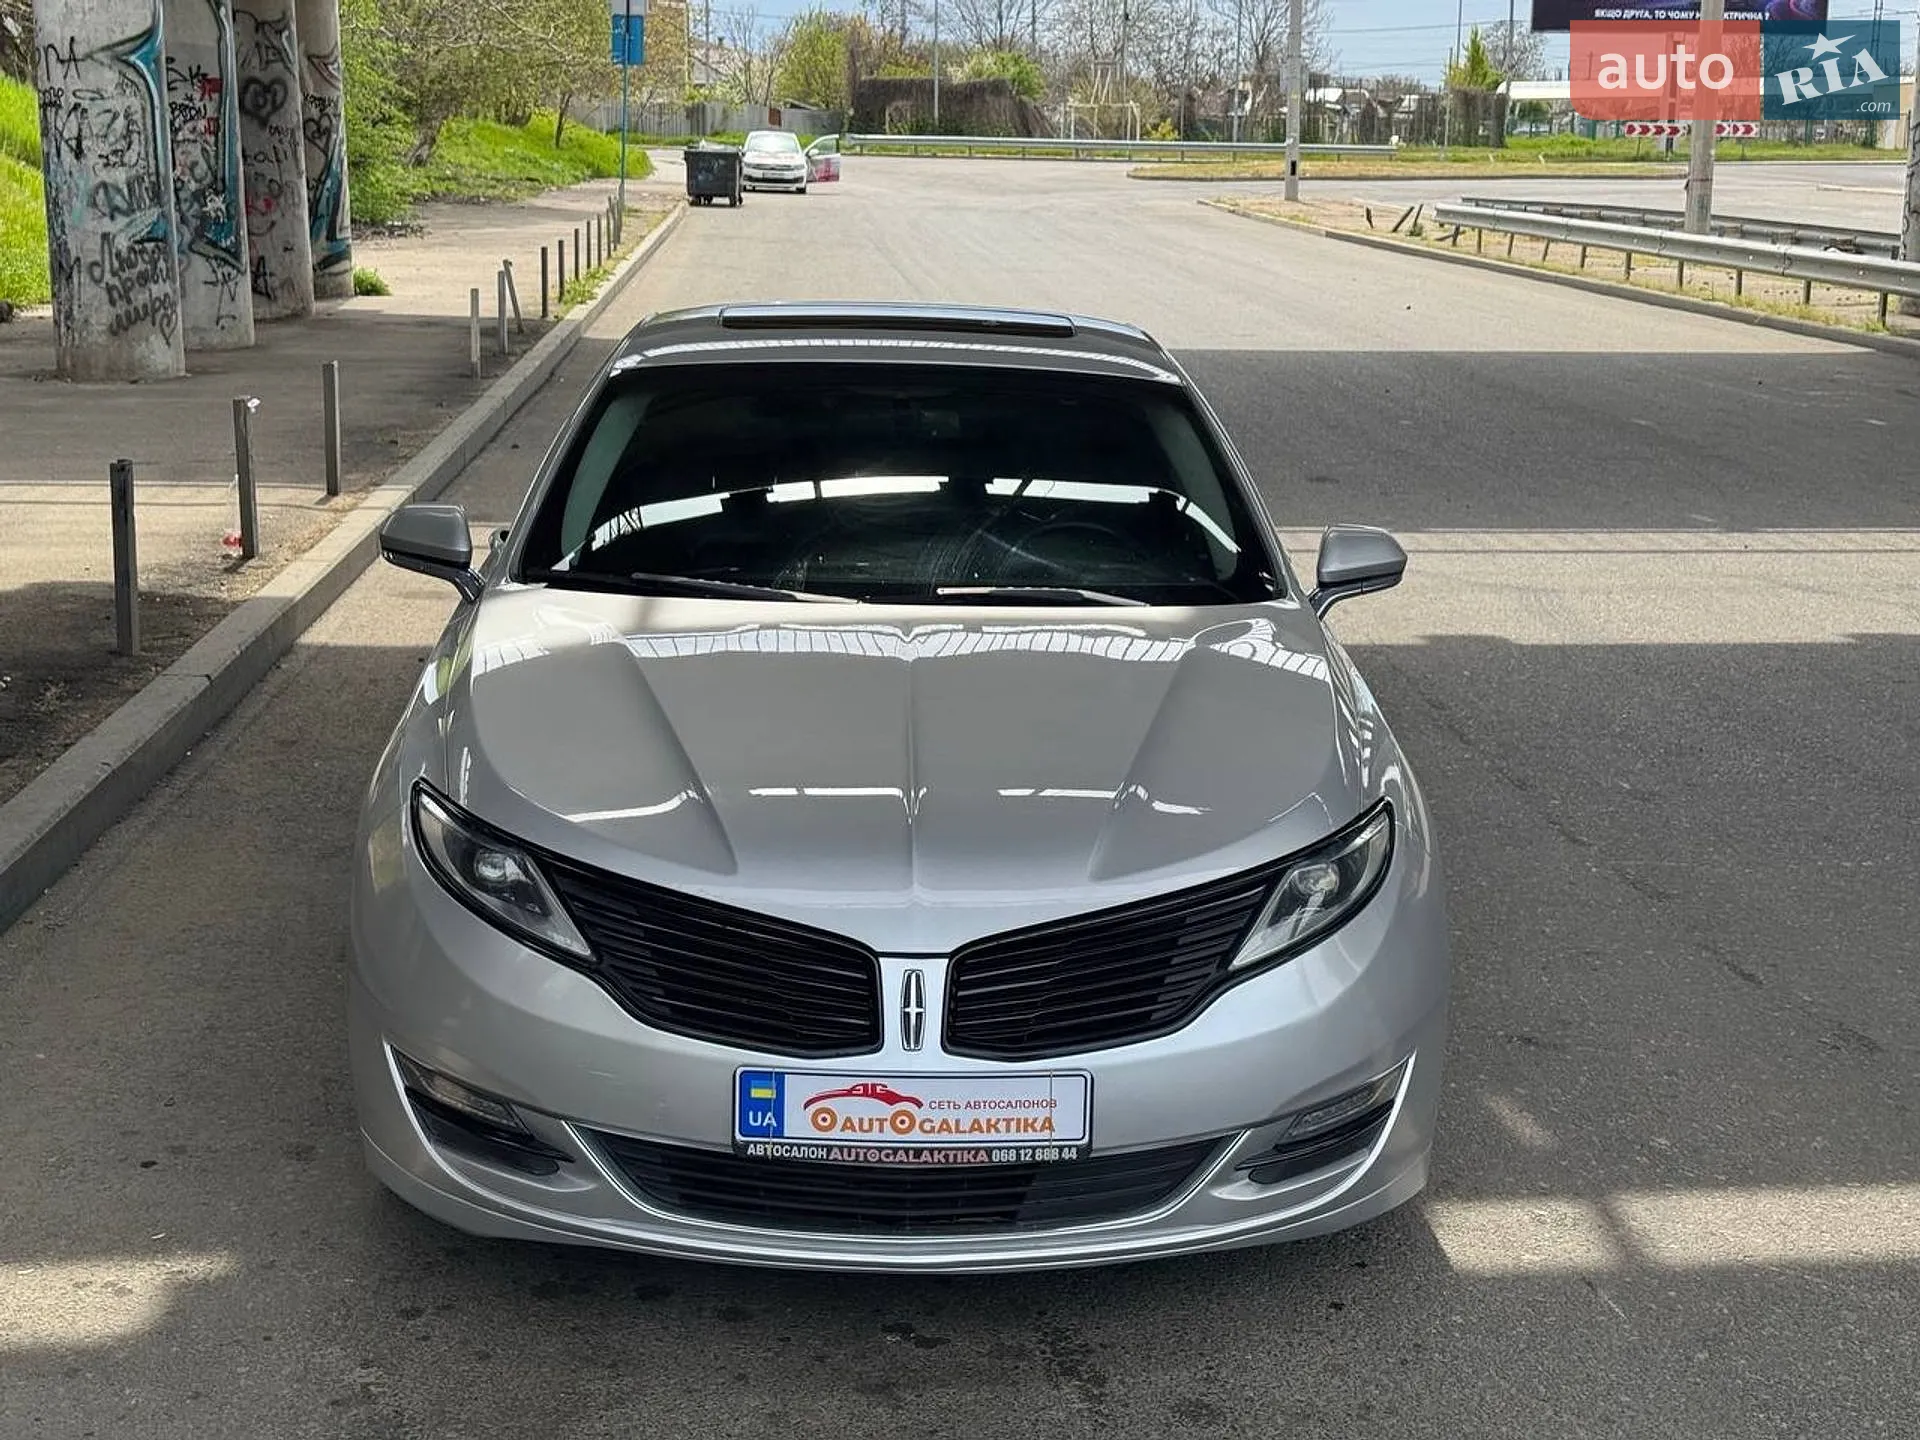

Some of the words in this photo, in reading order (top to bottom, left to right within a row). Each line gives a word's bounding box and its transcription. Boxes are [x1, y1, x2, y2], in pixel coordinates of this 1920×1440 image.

[1654, 10, 1667, 19] ТО
[1668, 10, 1695, 20] ЧОМУ
[928, 1099, 961, 1110] СЕТЬ
[964, 1099, 1057, 1110] АВТОСАЛОНОВ
[748, 1111, 777, 1127] UA
[839, 1108, 1056, 1136] AUTOGALAKTIKA
[747, 1143, 827, 1160] АВТОСАЛОН
[828, 1146, 989, 1164] AUTOGALAKTIKA
[991, 1149, 1017, 1163] 068
[1019, 1148, 1033, 1162] 12
[1061, 1146, 1078, 1160] 44
